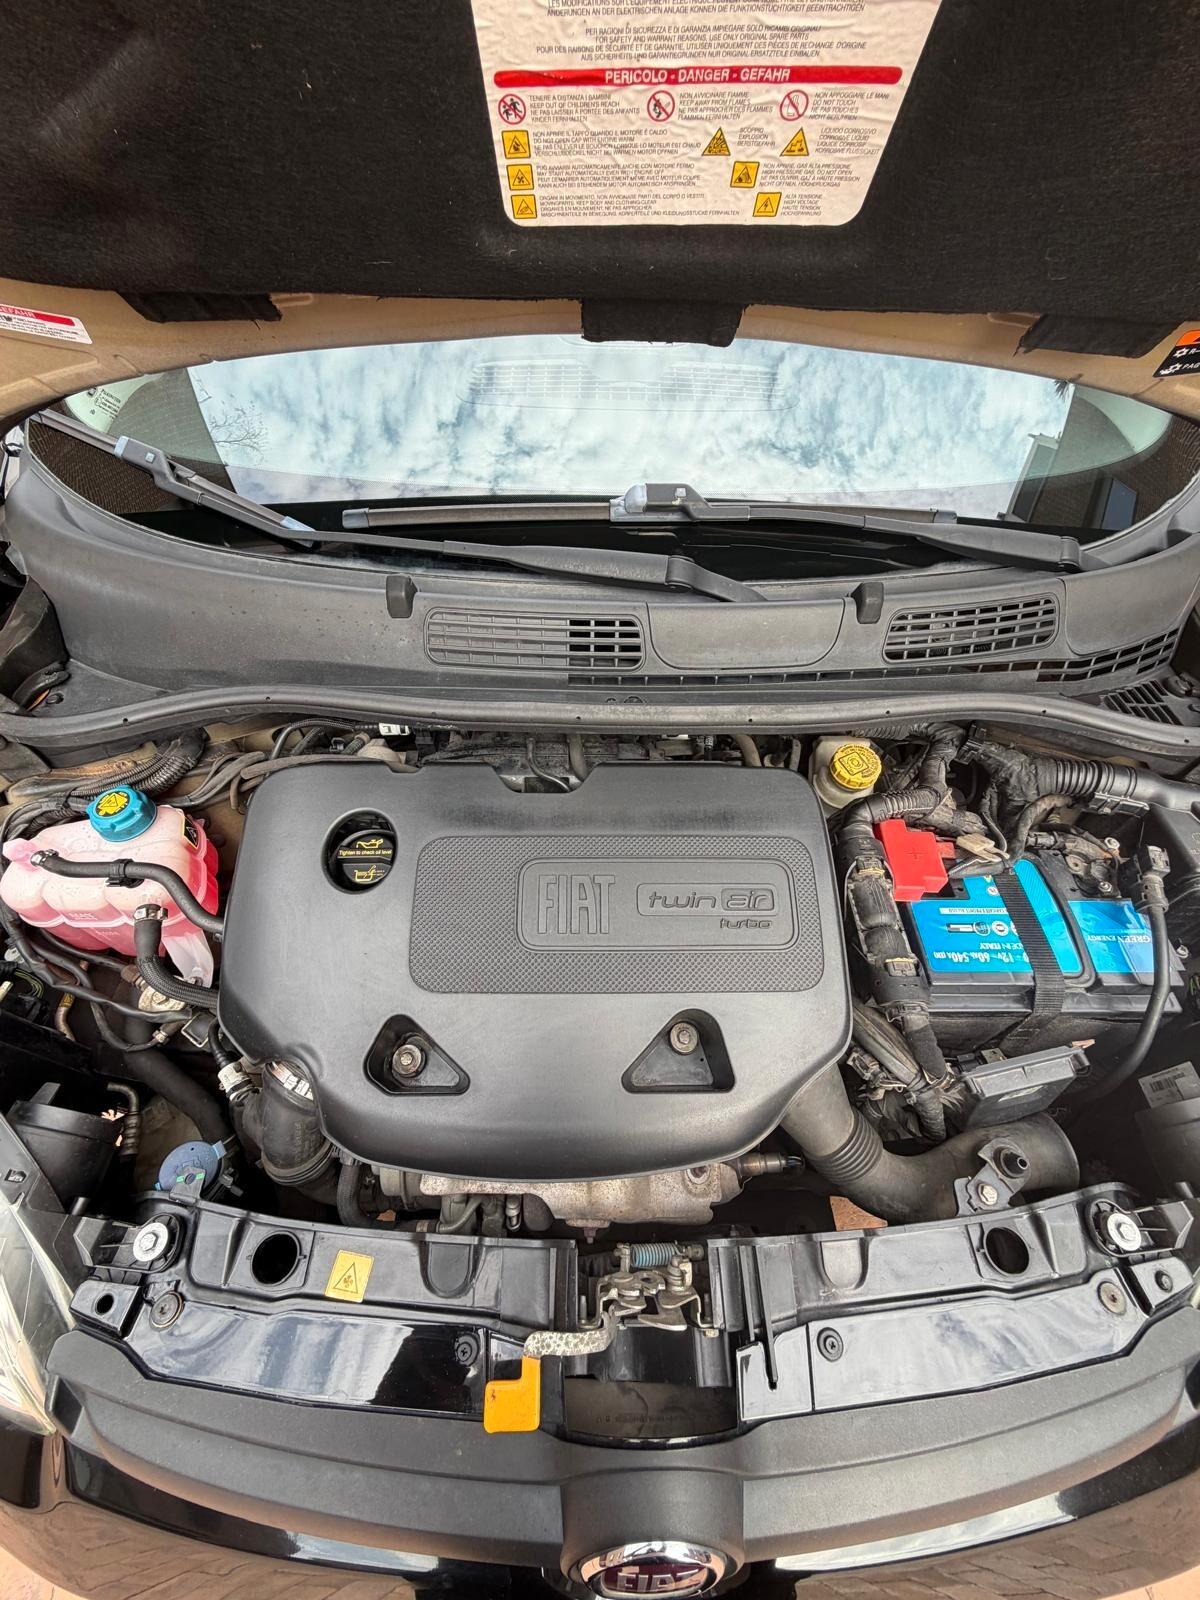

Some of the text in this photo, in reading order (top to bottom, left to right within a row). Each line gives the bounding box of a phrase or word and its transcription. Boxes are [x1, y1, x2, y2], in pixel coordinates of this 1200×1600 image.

[602, 7, 615, 15] DER
[616, 7, 664, 15] ELEKTRISCHEN
[664, 6, 688, 14] ANLAGE
[717, 6, 728, 14] DIE
[633, 26, 668, 34] SICUREZZA
[681, 24, 711, 33] GARANZIA
[747, 24, 764, 32] SOLO
[609, 36, 632, 44] SAFETY
[710, 34, 722, 42] USE
[722, 33, 738, 41] ONLY
[740, 33, 768, 41] ORIGINAL
[769, 32, 789, 40] SPARE
[790, 32, 810, 40] PARTS
[596, 44, 604, 52] DE
[636, 44, 644, 52] ET
[686, 42, 713, 50] UTILISER
[714, 41, 753, 50] UNIQUEMENT
[754, 41, 767, 49] DES
[790, 41, 800, 49] DE
[800, 40, 834, 49] RECHANGE
[722, 50, 750, 58] ORIGINAL
[604, 67, 790, 84] PERICOLO DANGER GEFAHR
[600, 100, 620, 108] REACH
[538, 874, 616, 934] FIAT
[649, 890, 774, 908] twin air
[719, 918, 773, 929] turbo
